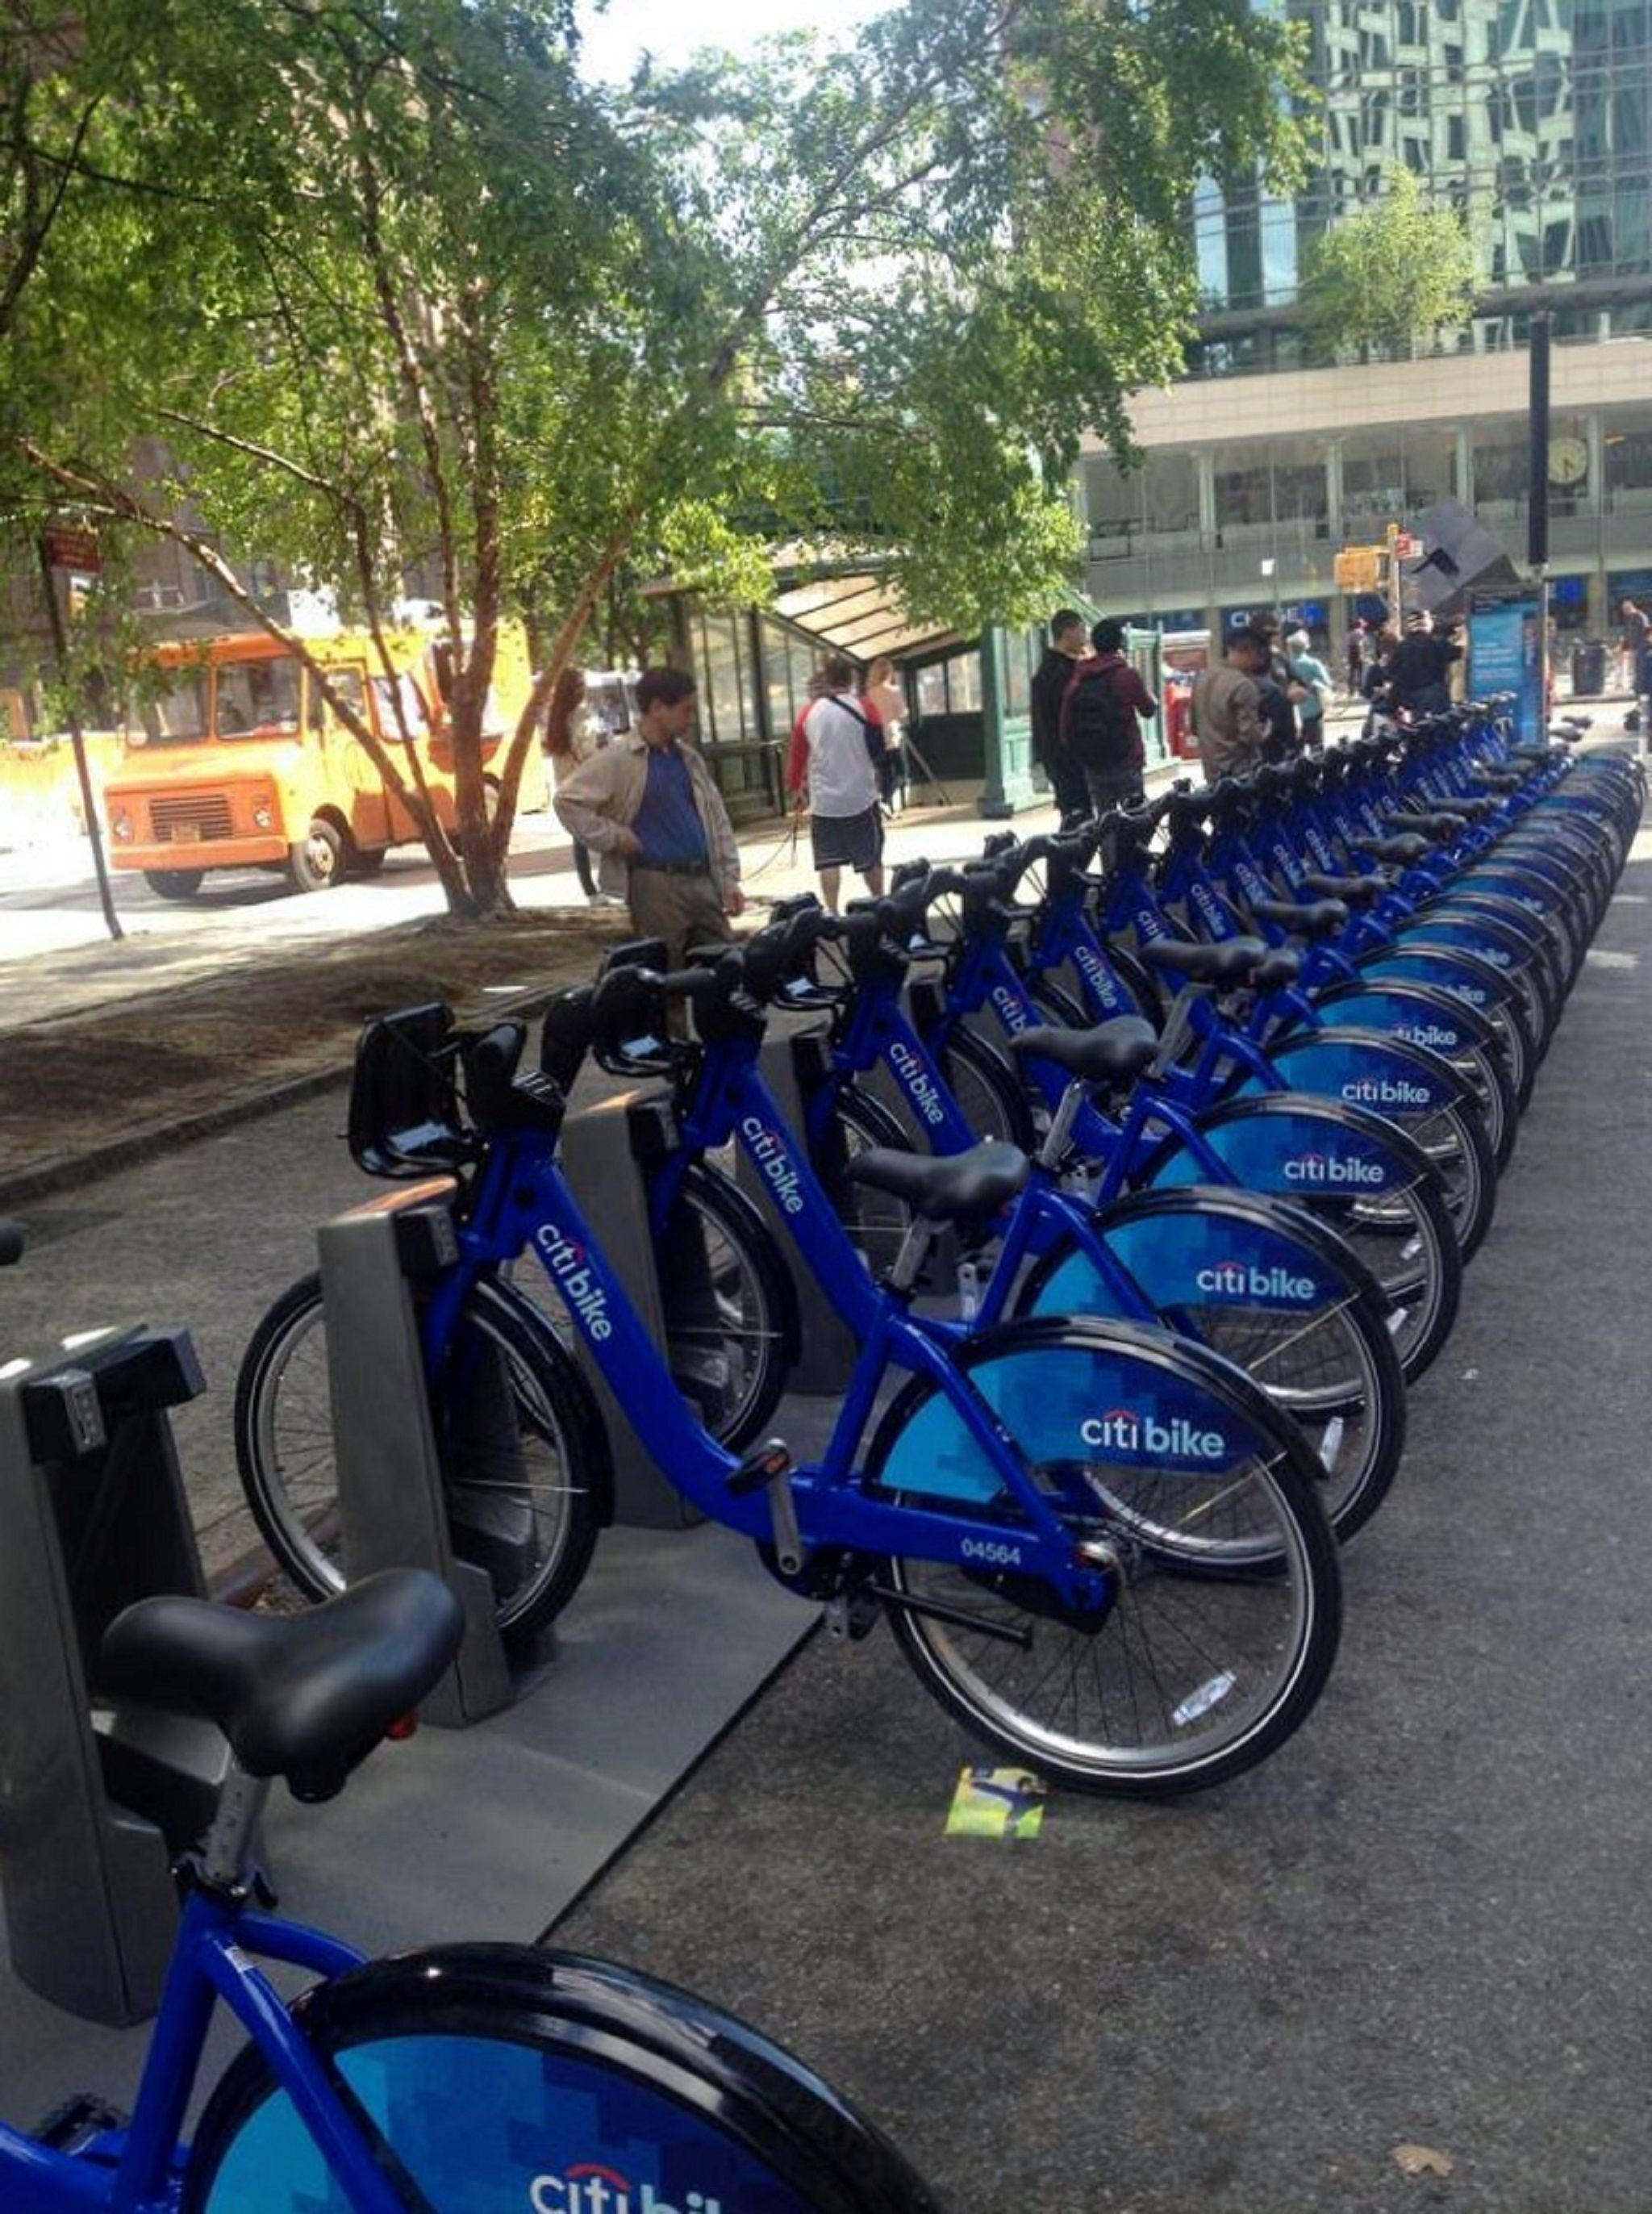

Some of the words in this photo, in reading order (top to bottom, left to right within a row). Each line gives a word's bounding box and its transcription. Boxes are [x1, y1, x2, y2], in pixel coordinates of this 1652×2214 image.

[1074, 946, 1099, 974] citi
[1090, 968, 1118, 1008] bike
[992, 985, 1020, 1021] citi
[890, 1042, 918, 1080] citi
[909, 1073, 945, 1125] bike
[1342, 1080, 1379, 1101] citi
[1381, 1080, 1431, 1104] bike
[741, 1117, 778, 1160] citi
[765, 1154, 804, 1214] bike
[1284, 1155, 1325, 1180] citi
[1328, 1156, 1384, 1183] bike
[536, 1223, 579, 1276] citi
[564, 1267, 612, 1341] bike
[1196, 1264, 1246, 1294] citi
[1250, 1266, 1316, 1300] bike
[1080, 1414, 1139, 1451] citi
[1145, 1416, 1224, 1459] bike
[961, 1537, 1022, 1564] 04564
